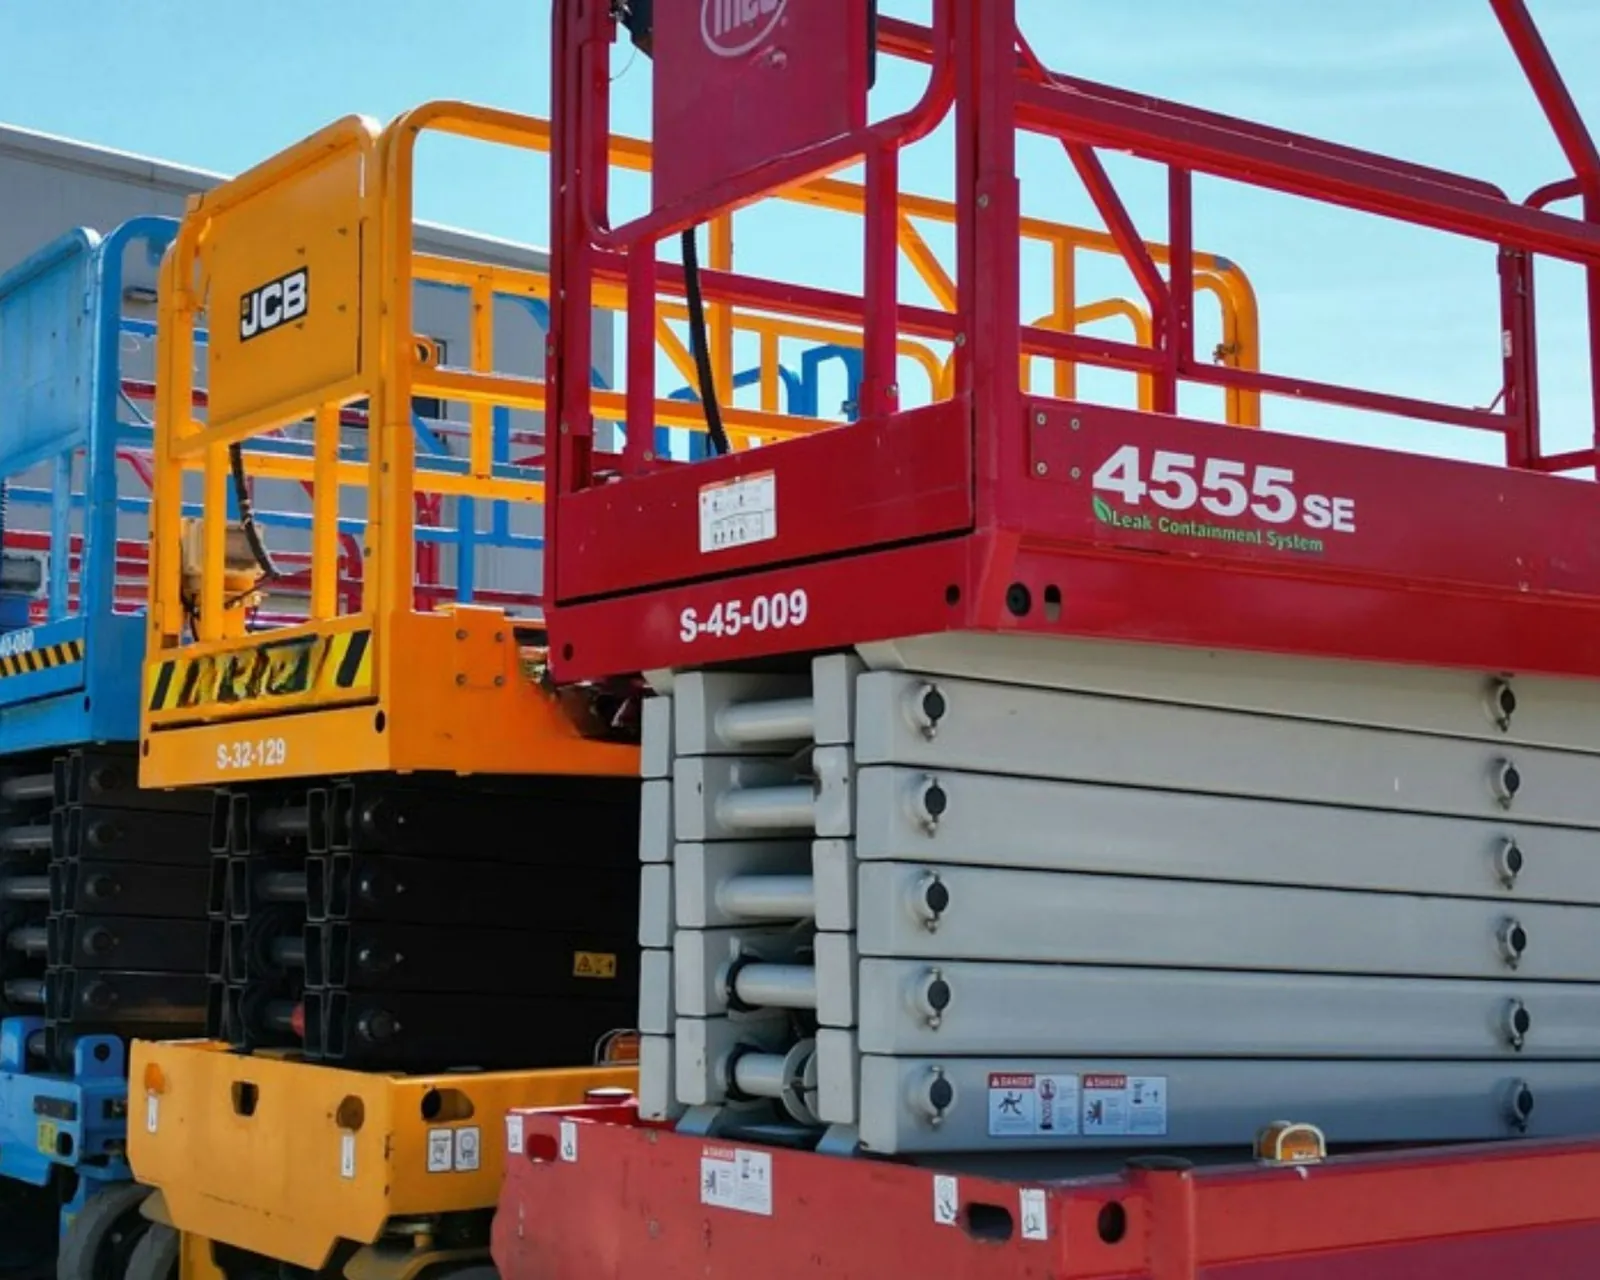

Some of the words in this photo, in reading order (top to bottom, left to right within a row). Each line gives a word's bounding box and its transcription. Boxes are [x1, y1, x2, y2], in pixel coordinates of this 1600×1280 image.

[241, 271, 306, 338] JCB
[1092, 444, 1297, 523] 4555
[1302, 493, 1356, 533] SE
[1112, 509, 1152, 531] Leak
[1158, 516, 1262, 545] Containment
[1266, 529, 1323, 551] System
[679, 587, 808, 643] S-45-009
[216, 737, 285, 770] S-32-129
